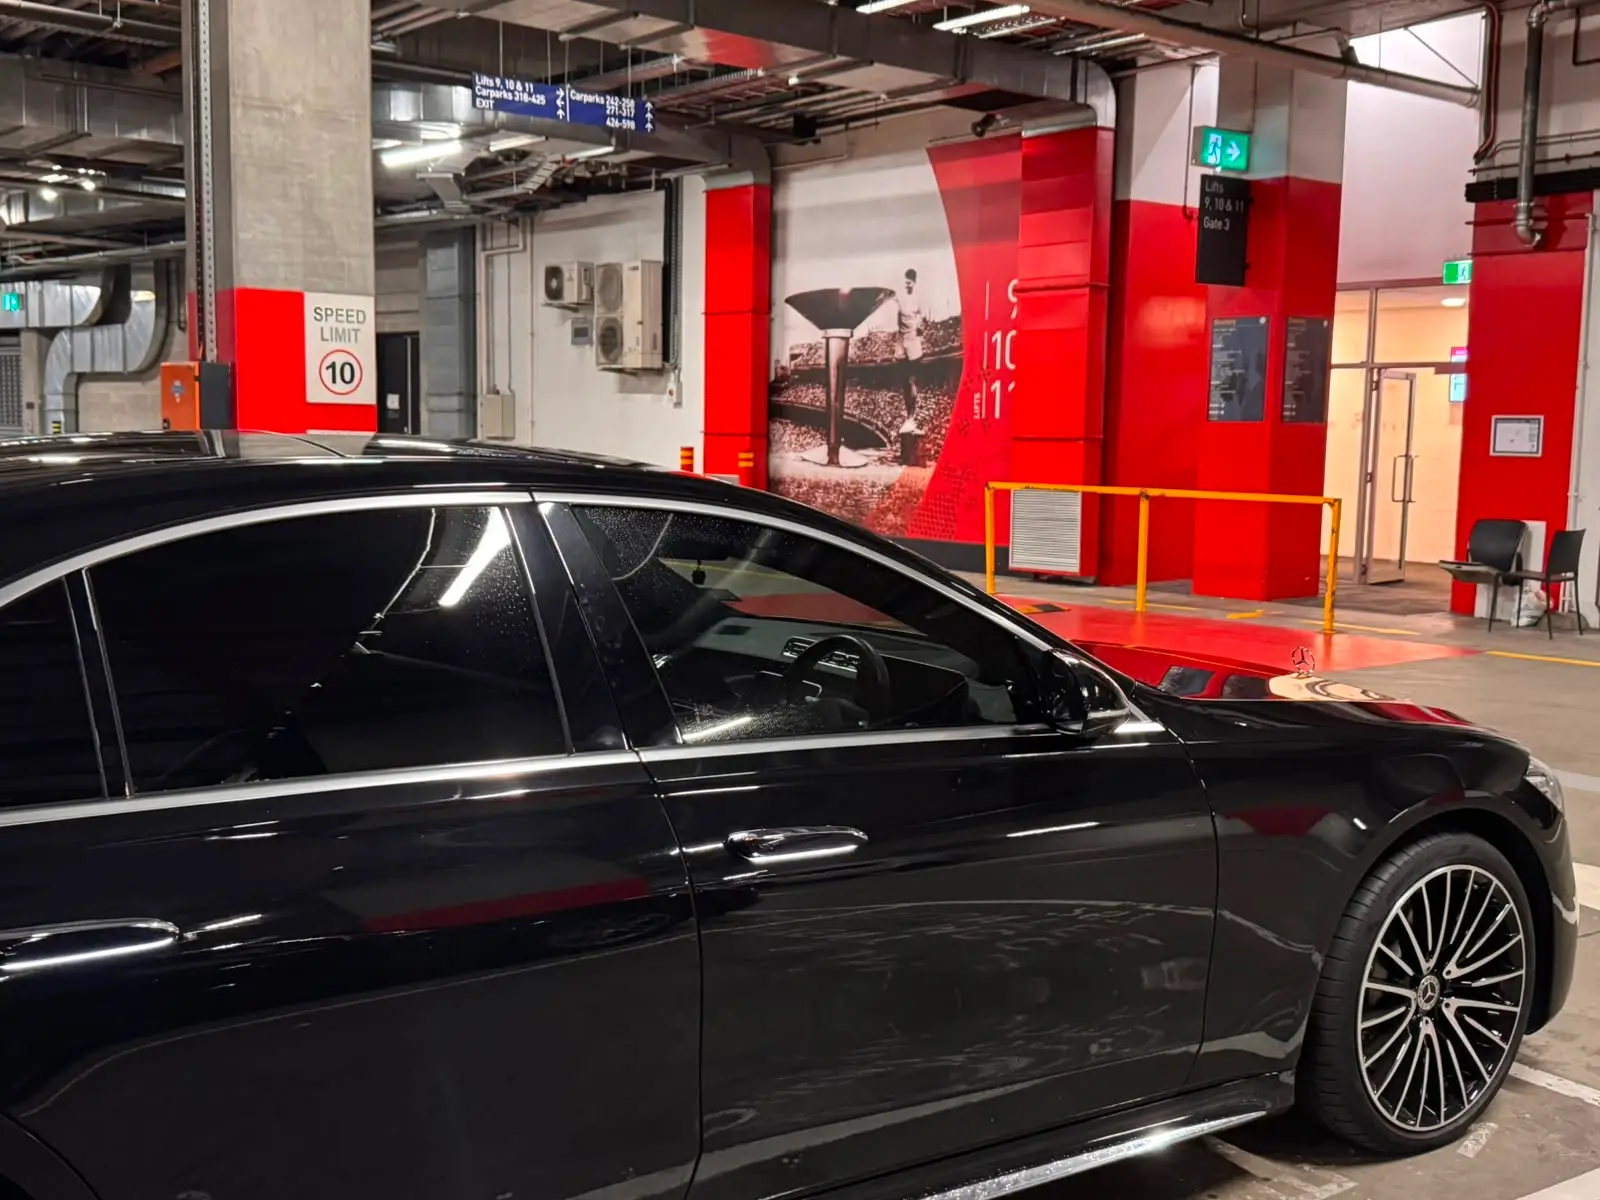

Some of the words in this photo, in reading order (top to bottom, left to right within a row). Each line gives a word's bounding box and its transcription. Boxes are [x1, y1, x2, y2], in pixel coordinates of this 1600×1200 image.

[475, 73, 494, 86] Lifts
[495, 77, 503, 89] 9,
[505, 78, 514, 90] 10
[516, 80, 523, 91] &
[525, 82, 534, 93] 11
[475, 85, 513, 100] Carparks
[570, 89, 605, 104] Carparks
[1205, 179, 1224, 194] Lifts
[1204, 196, 1212, 211] 9,
[1214, 197, 1224, 211] 10
[1225, 198, 1233, 212] &
[1235, 199, 1244, 213] 11
[1203, 216, 1223, 230] Gate
[1223, 218, 1230, 231] 3
[313, 306, 366, 324] SPEED
[320, 326, 361, 344] LIMIT
[325, 361, 355, 384] 10
[973, 392, 981, 419] LIFTS
